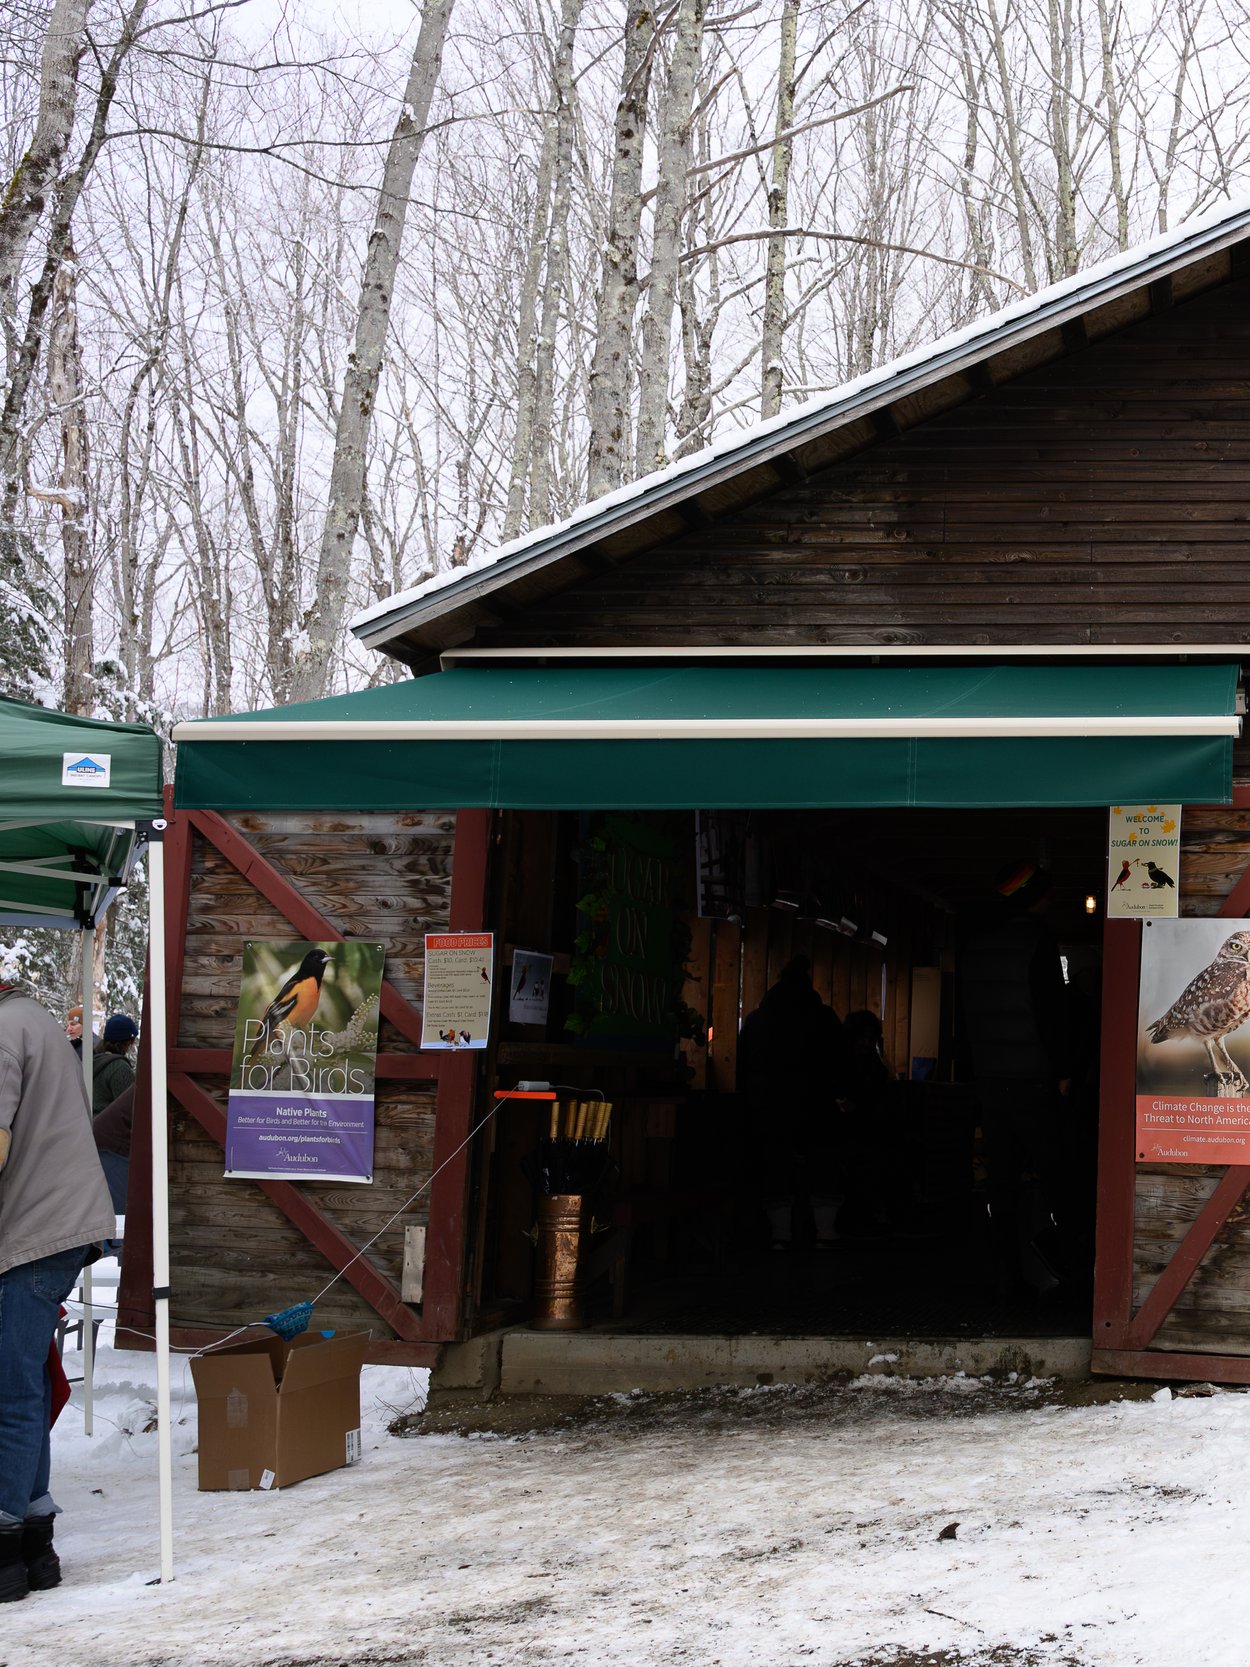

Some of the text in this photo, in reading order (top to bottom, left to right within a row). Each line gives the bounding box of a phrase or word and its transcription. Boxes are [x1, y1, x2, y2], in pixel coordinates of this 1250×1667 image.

[1126, 815, 1164, 823] WELCOME
[1139, 827, 1150, 835] TO
[1138, 839, 1150, 847] ON
[1151, 839, 1178, 847] SNOW!
[434, 937, 488, 947] FOOD PRICES
[242, 1018, 335, 1057] Plants
[239, 1054, 365, 1095] for Birds
[276, 1107, 327, 1118] Native Plants
[1152, 1101, 1188, 1112] Climate
[1189, 1102, 1225, 1115] Change
[1226, 1103, 1235, 1113] is
[237, 1116, 256, 1124] Better
[292, 1118, 311, 1126] Better
[328, 1120, 364, 1128] Environment
[1144, 1113, 1174, 1123] Threat
[1175, 1114, 1185, 1124] to
[1187, 1115, 1214, 1125] North
[258, 1134, 341, 1144] audubon.org/plantsforbirds
[1183, 1135, 1246, 1145] climate.audubon.org
[283, 1152, 318, 1163] Audubon
[1157, 1148, 1188, 1157] Audubon
